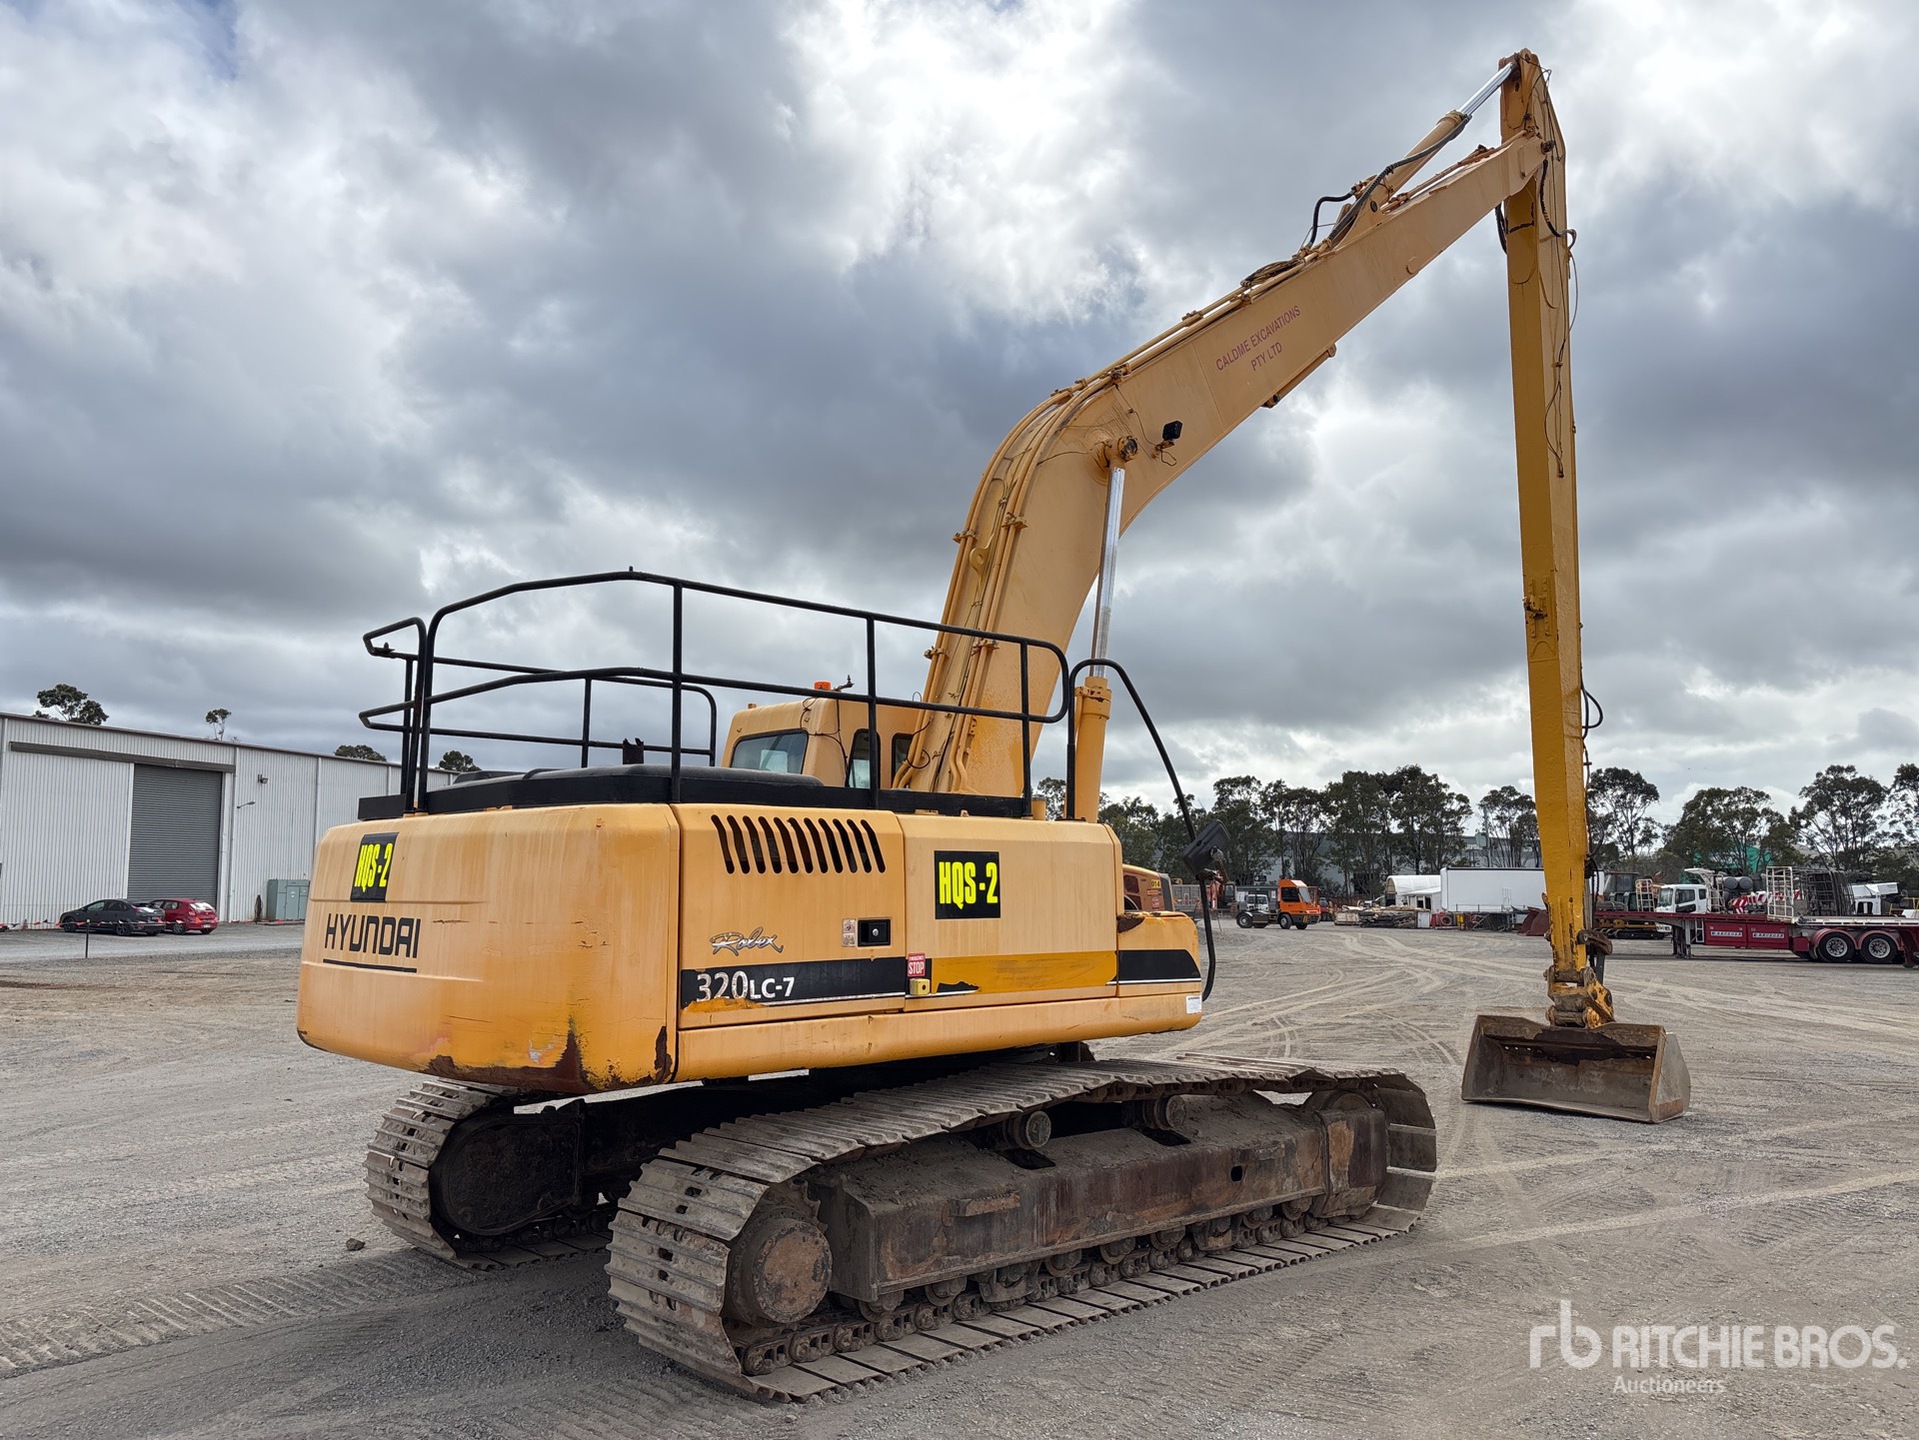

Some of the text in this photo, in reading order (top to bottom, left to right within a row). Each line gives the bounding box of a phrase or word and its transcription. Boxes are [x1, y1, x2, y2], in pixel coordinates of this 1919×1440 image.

[1215, 305, 1301, 371] CALDME EXCAVATIONS
[1251, 342, 1283, 371] PTY LTD
[354, 843, 394, 893] HQS-2
[939, 861, 998, 910] HQS-2
[324, 912, 421, 959] HYUNDAI
[709, 926, 784, 956] Robex
[908, 961, 925, 975] STOP
